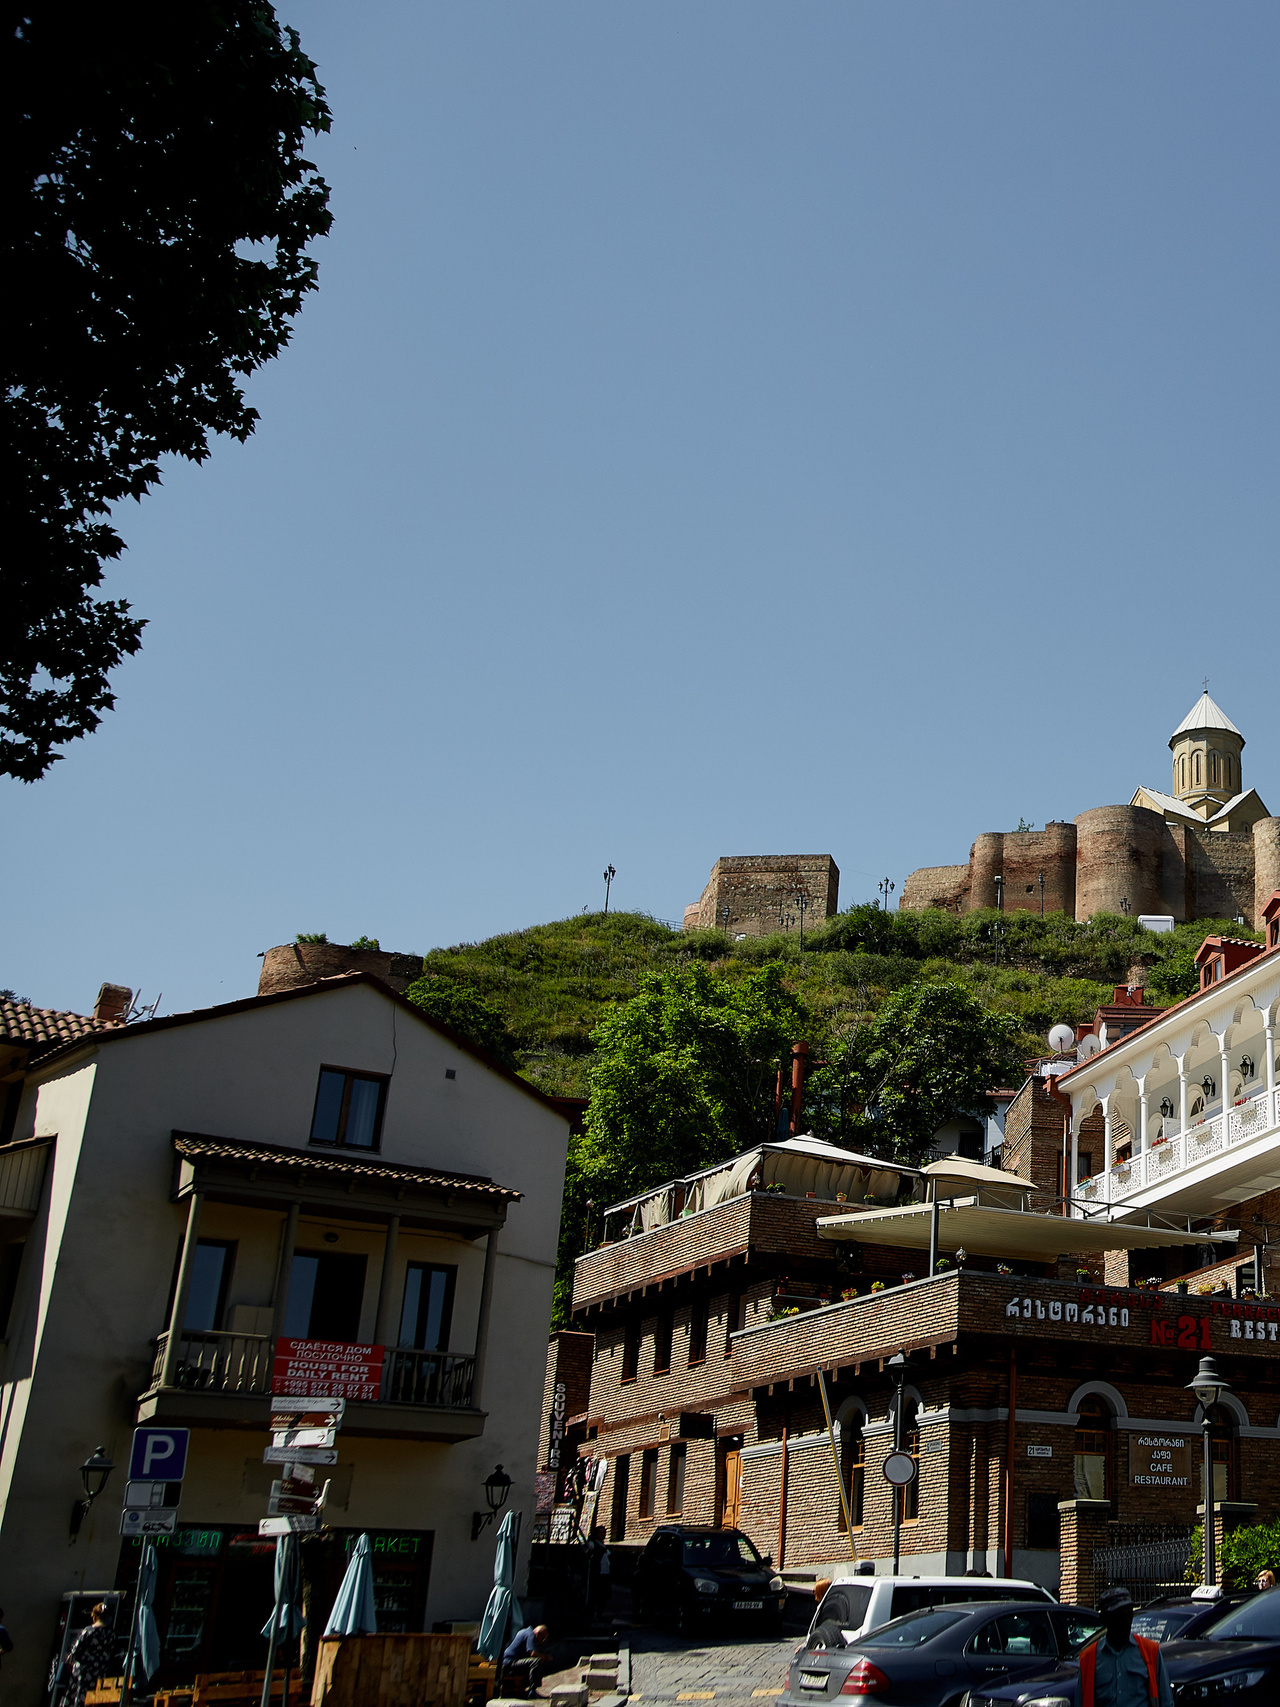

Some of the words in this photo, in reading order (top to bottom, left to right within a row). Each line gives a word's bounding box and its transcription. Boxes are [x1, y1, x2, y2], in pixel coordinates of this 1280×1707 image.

[1005, 1296, 1129, 1327] რესტორანი
[289, 1341, 343, 1353] СДАЁТСЯ
[346, 1345, 372, 1355] ДОМ
[296, 1350, 363, 1362] ПОСУТОЧНО
[288, 1361, 337, 1371] HOUSE
[341, 1365, 370, 1373] FOR
[286, 1369, 327, 1378] DAILY
[331, 1373, 370, 1382] RENT
[550, 1382, 566, 1468] SOUVENIRS
[1137, 1436, 1185, 1448] რესტორანი
[142, 1434, 176, 1475] P
[1151, 1450, 1171, 1460] კაფე
[1150, 1462, 1173, 1473] CAFE
[1134, 1475, 1188, 1486] RESTAURANT
